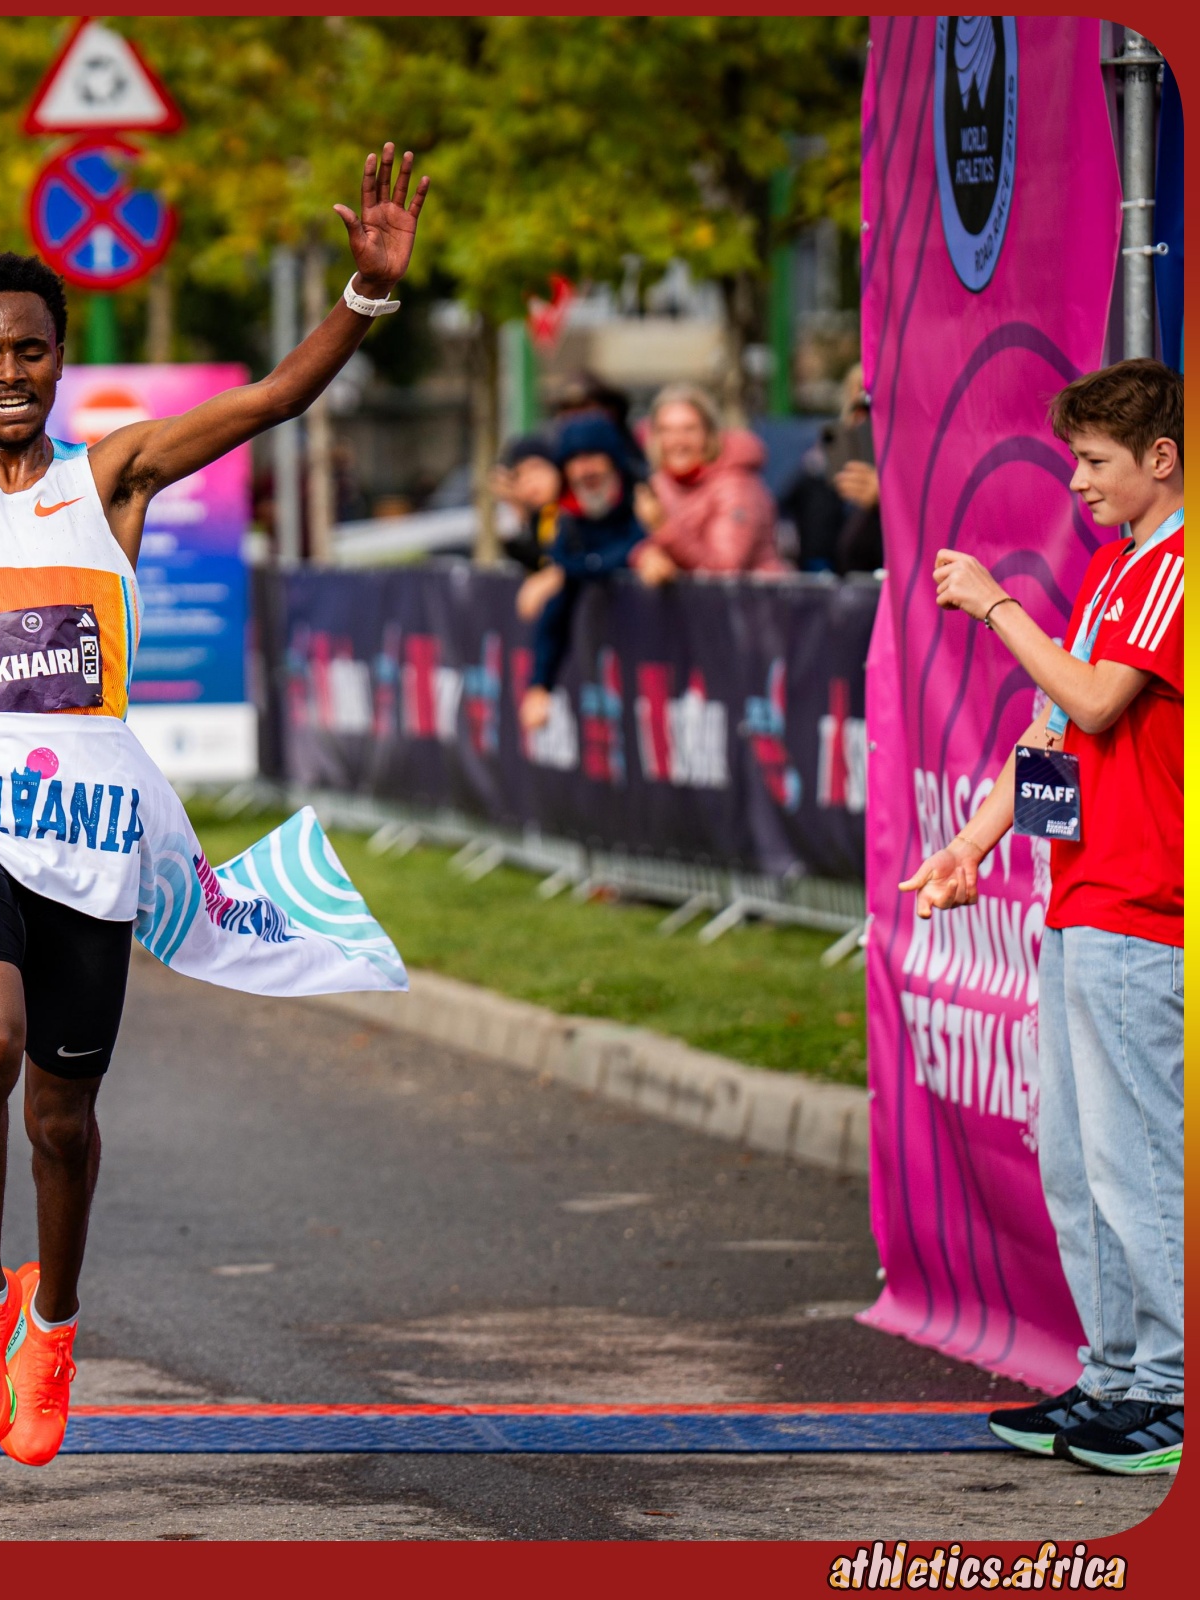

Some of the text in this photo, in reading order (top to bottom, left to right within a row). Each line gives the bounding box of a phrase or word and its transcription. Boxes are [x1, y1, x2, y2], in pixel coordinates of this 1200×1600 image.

[960, 125, 988, 153] WORLD
[955, 156, 995, 185] ATHLETICS
[974, 232, 994, 273] ROAD
[993, 172, 1010, 241] RACE
[1020, 781, 1075, 803] STAFF
[900, 990, 1029, 1123] FESTIVAL
